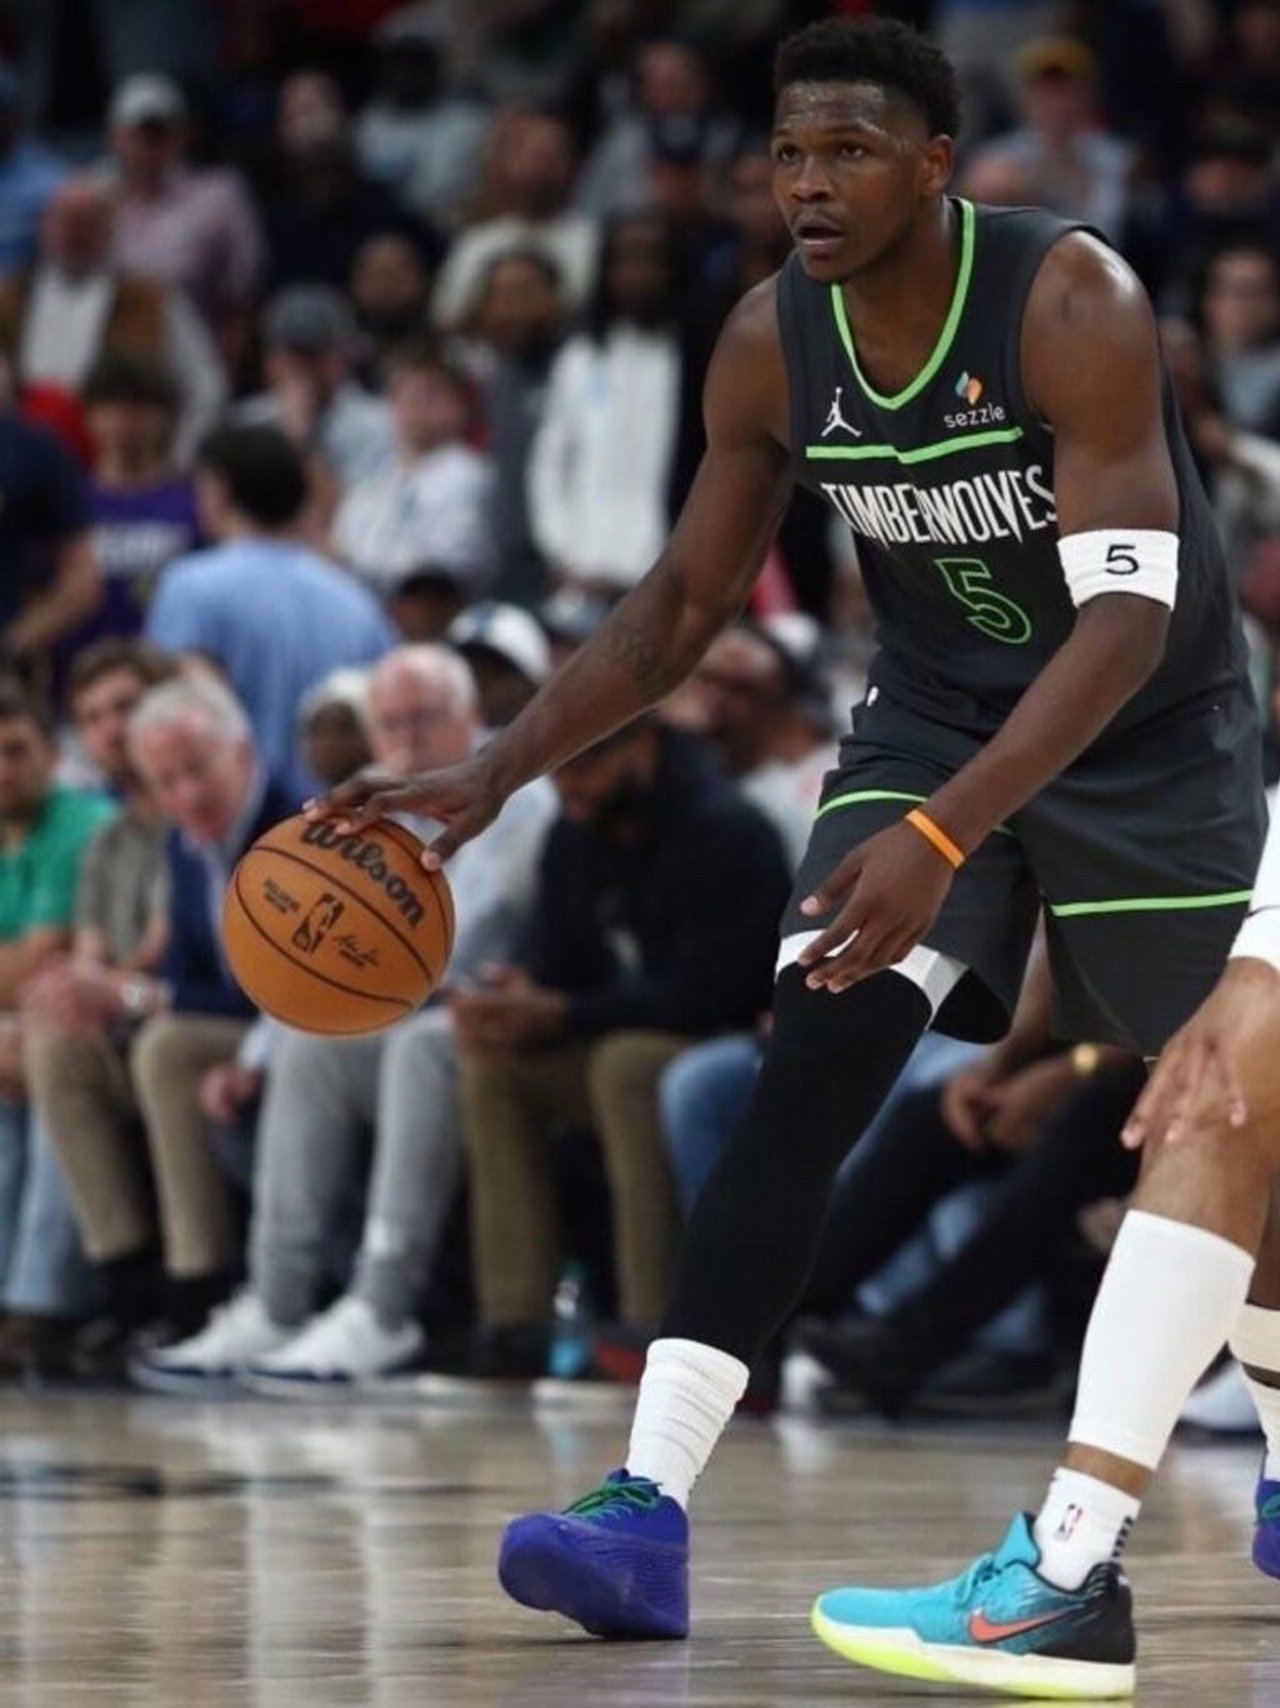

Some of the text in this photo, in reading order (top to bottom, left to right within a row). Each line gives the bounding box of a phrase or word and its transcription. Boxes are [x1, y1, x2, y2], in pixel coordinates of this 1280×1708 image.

[943, 402, 1006, 428] sezzle
[821, 465, 1057, 549] TIMBERWOLVES
[1105, 544, 1140, 576] 5
[934, 558, 1032, 644] 5
